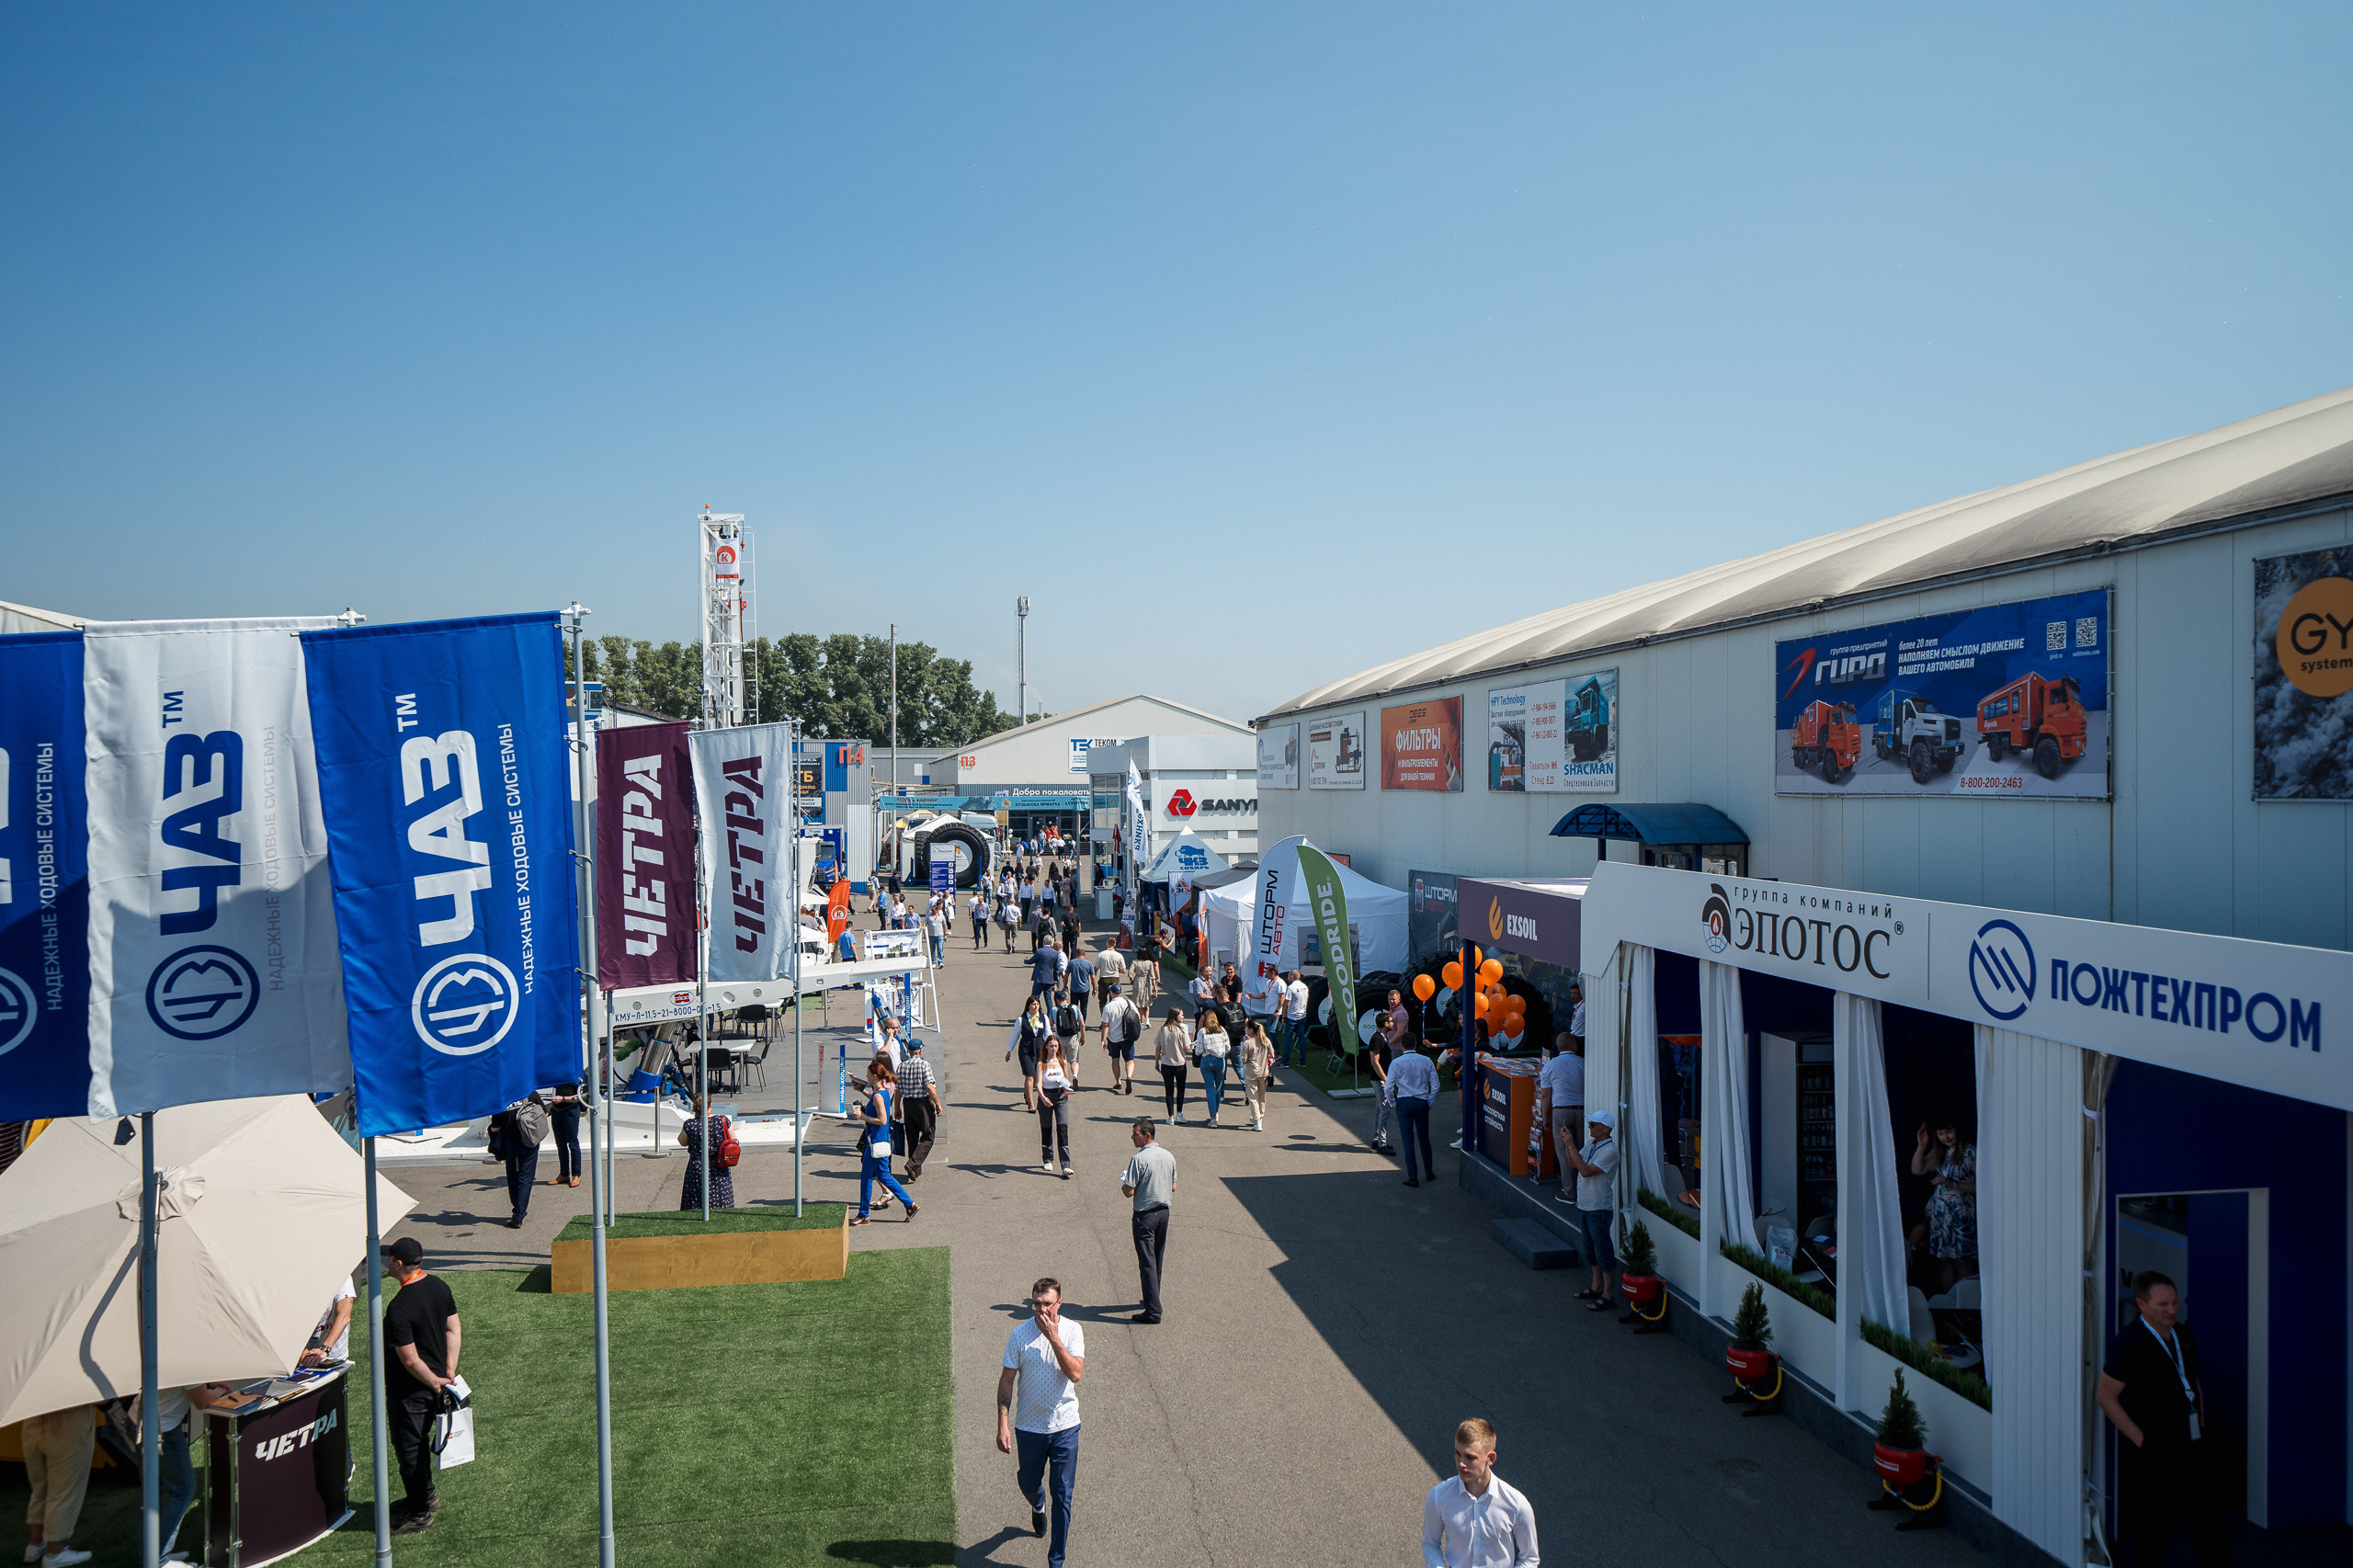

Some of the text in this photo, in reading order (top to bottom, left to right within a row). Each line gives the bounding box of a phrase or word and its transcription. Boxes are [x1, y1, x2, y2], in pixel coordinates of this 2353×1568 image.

[1814, 653, 1887, 686] ГИРД
[1830, 640, 1888, 656] группа предприятий
[1898, 638, 1938, 651] более 20 лет
[1898, 638, 2025, 664] НАПОЛНЯЕМ СМЫСЛОМ ДВИЖЕНИЕ
[1898, 658, 1975, 676] ВАШЕГО АВТОМОБИЛЯ
[1500, 694, 1526, 706] Technology
[497, 723, 521, 806] СИСТЕМЫ
[839, 746, 865, 764] П4
[1396, 727, 1441, 752] ФИЛЬТРЫ
[37, 743, 54, 825] СИСТЕМЫ
[264, 726, 278, 810] СИСТЕМЫ
[1013, 788, 1040, 797] Добро
[1563, 762, 1614, 775] SHACMAN
[1960, 777, 2022, 789] 8-800-200-2463
[160, 731, 244, 936] ЧАЗ
[264, 812, 281, 893] ХОДОВЫЕ
[401, 730, 493, 948] ЧАЗ
[508, 810, 529, 893] ХОДОВЫЕ
[622, 755, 667, 957] ЧЕТРА
[722, 756, 767, 954] ЧЕТРА
[38, 830, 58, 906] ХОДОВЫЕ
[1178, 858, 1208, 866] ЧКЗ
[1260, 869, 1279, 954] ШТОРМ
[1425, 885, 1458, 903] ШТОРМ
[1734, 886, 1892, 918] группа компаний
[266, 897, 284, 991] НАДЕЖНЫЕ
[517, 896, 534, 994] НАДЕЖНЫЕ
[1272, 905, 1285, 956] АВТО
[1506, 914, 1538, 941] EXSOIL
[42, 913, 63, 1010] НАДЕЖНЫЕ
[2051, 959, 2321, 1052] ПОЖТЕХПРОМ
[255, 1408, 337, 1461] ЧЕТРА
